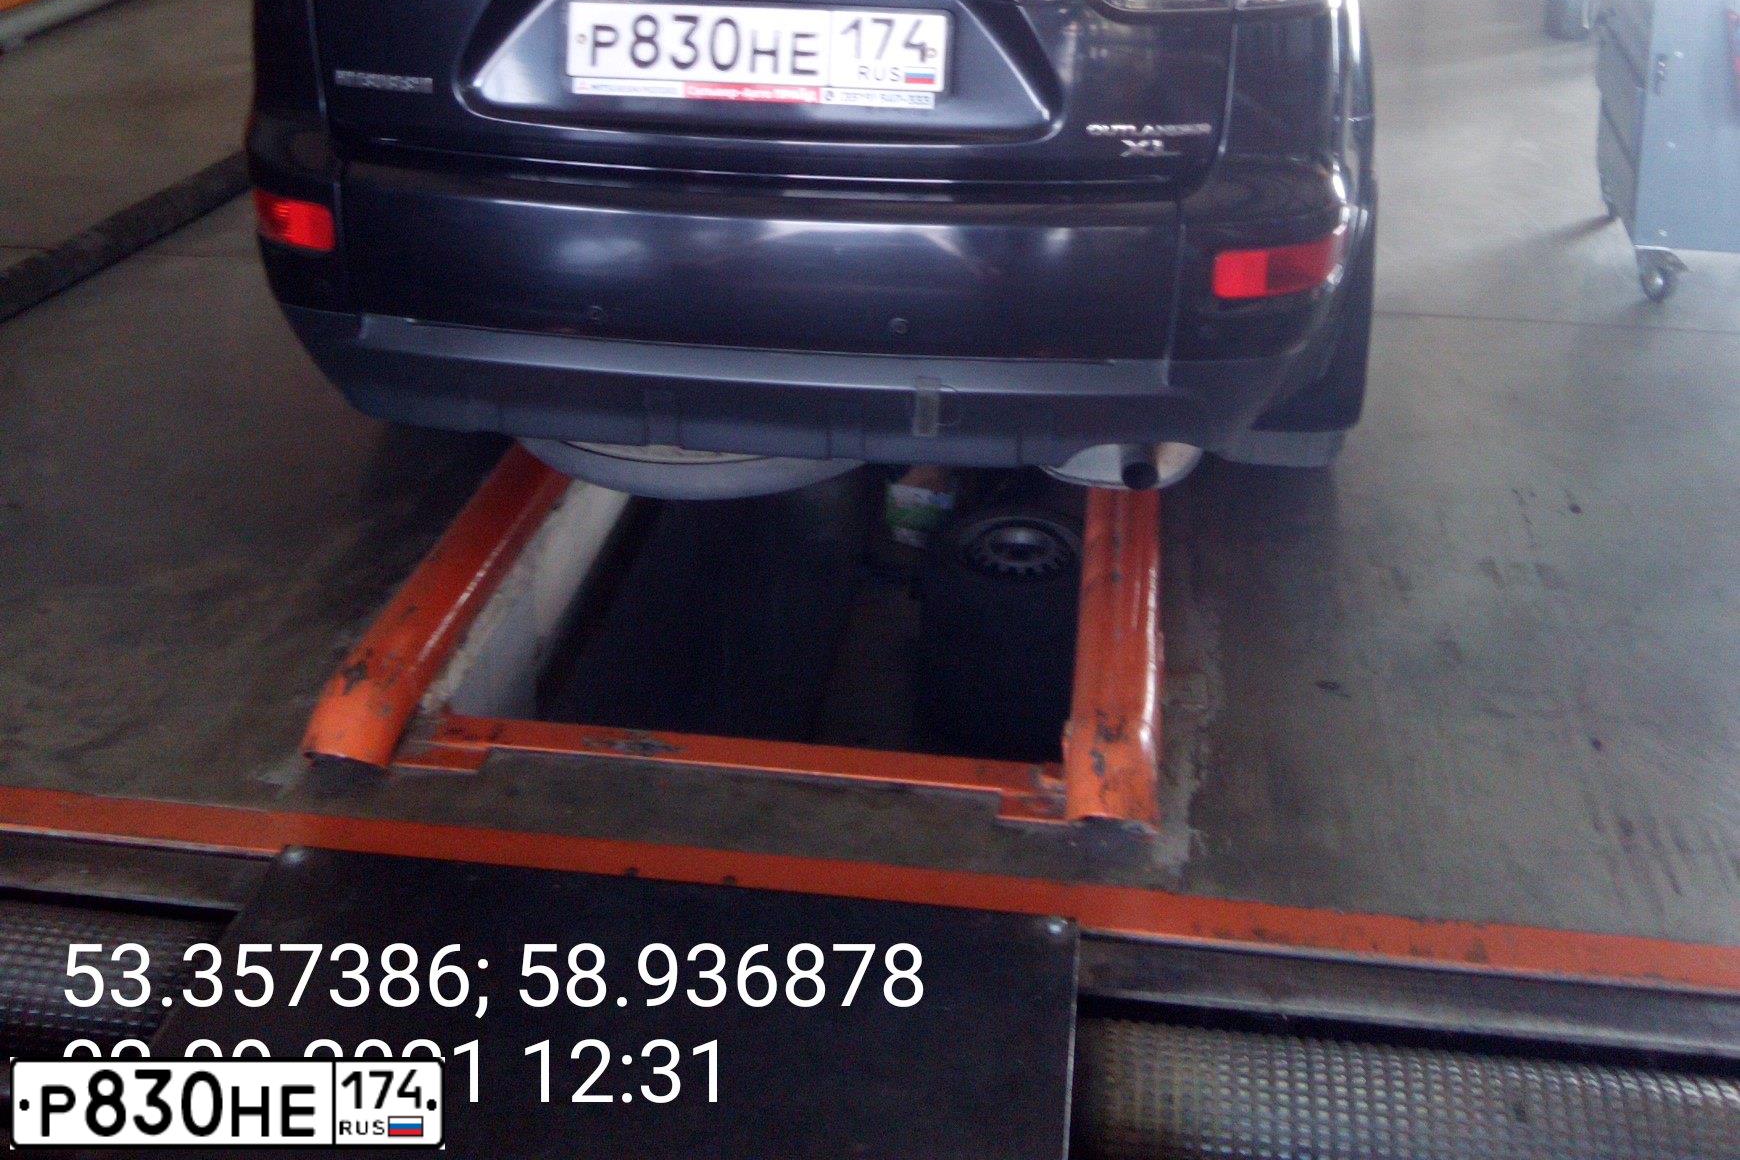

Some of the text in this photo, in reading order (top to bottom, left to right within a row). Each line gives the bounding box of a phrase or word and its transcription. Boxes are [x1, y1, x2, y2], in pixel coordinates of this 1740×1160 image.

[590, 14, 928, 76] Р830НЕ 174
[857, 65, 901, 81] RUS
